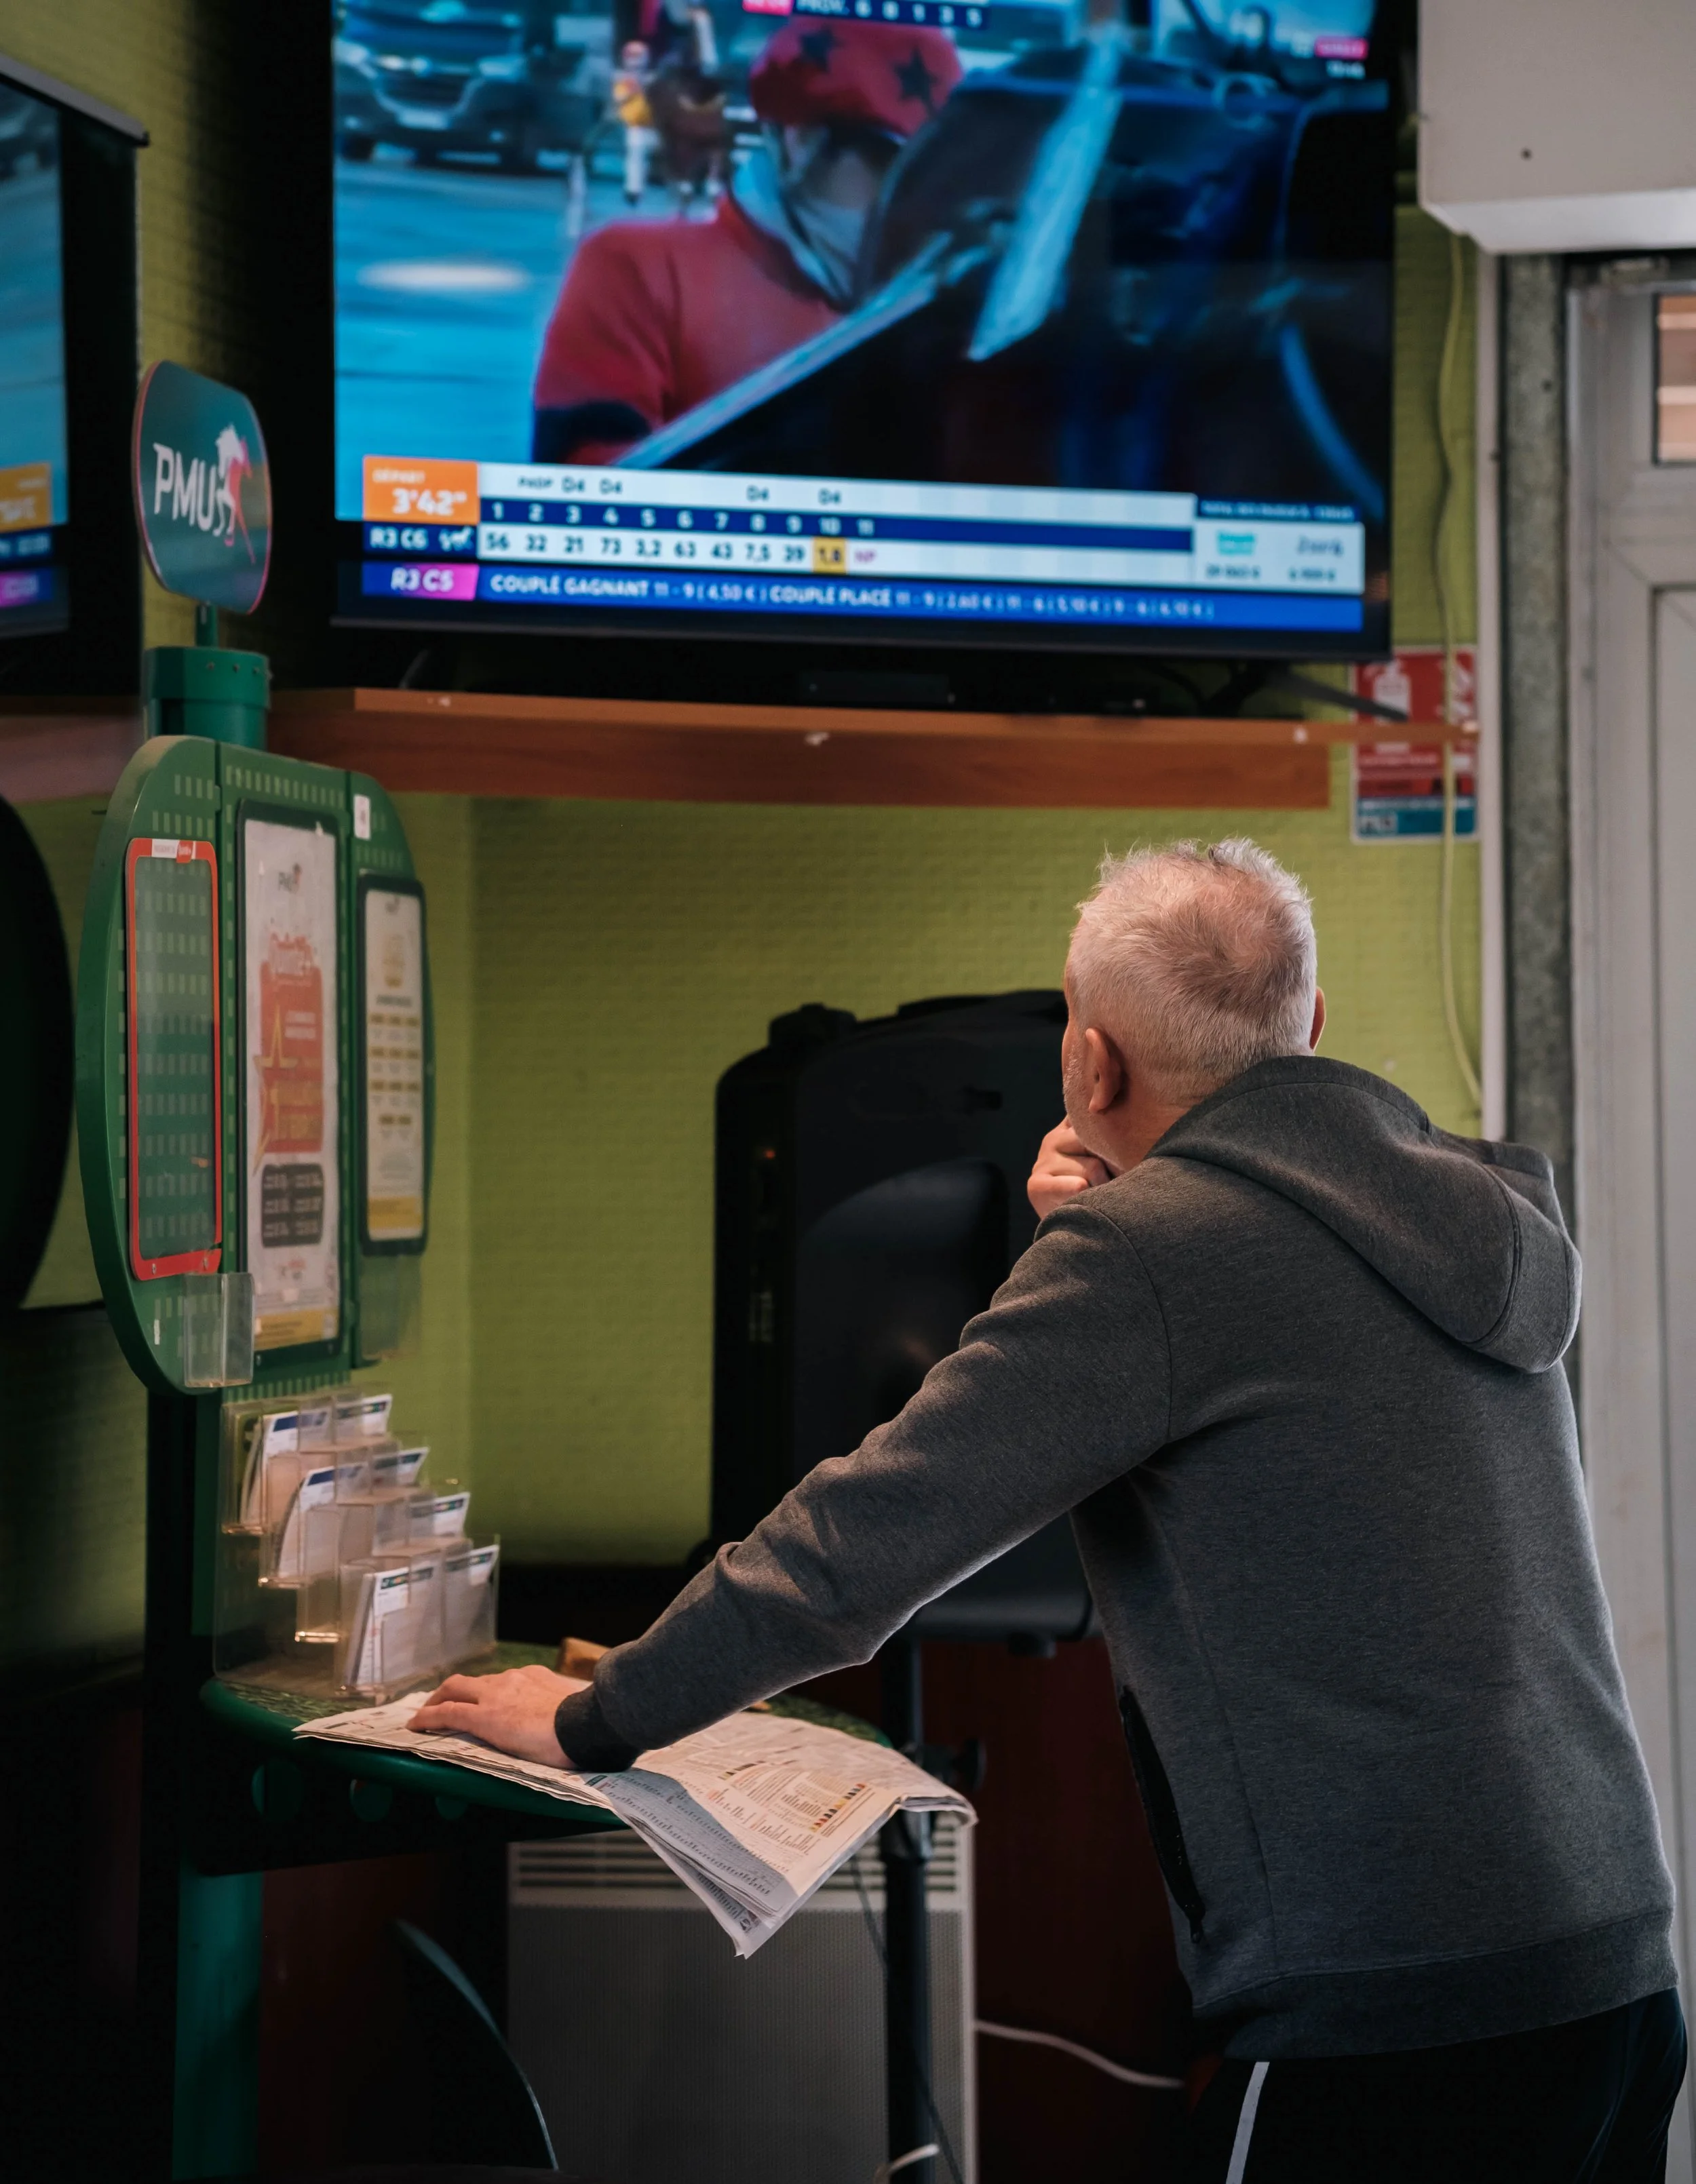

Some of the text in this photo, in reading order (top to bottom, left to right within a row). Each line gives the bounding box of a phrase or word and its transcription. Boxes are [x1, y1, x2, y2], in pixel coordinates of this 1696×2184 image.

[153, 442, 216, 531] PMU
[562, 477, 585, 492] D4
[600, 479, 622, 494] D4
[747, 485, 769, 501] D4
[819, 488, 841, 505] D4
[493, 503, 874, 536] 1 2 3 4 5 6 7 8 9 10 11
[370, 528, 428, 549] R3 C6
[487, 532, 508, 550] 56
[565, 536, 583, 553] 21
[602, 538, 621, 555] 73
[637, 539, 661, 558] 3,2
[674, 542, 696, 558] 63
[711, 543, 733, 560] 43
[747, 543, 769, 562] 7,5
[391, 568, 454, 591] R3 C5
[490, 574, 560, 594] COUPLÉ
[564, 579, 648, 596] GAGNANT
[654, 583, 669, 596] 11
[683, 583, 695, 598] 9
